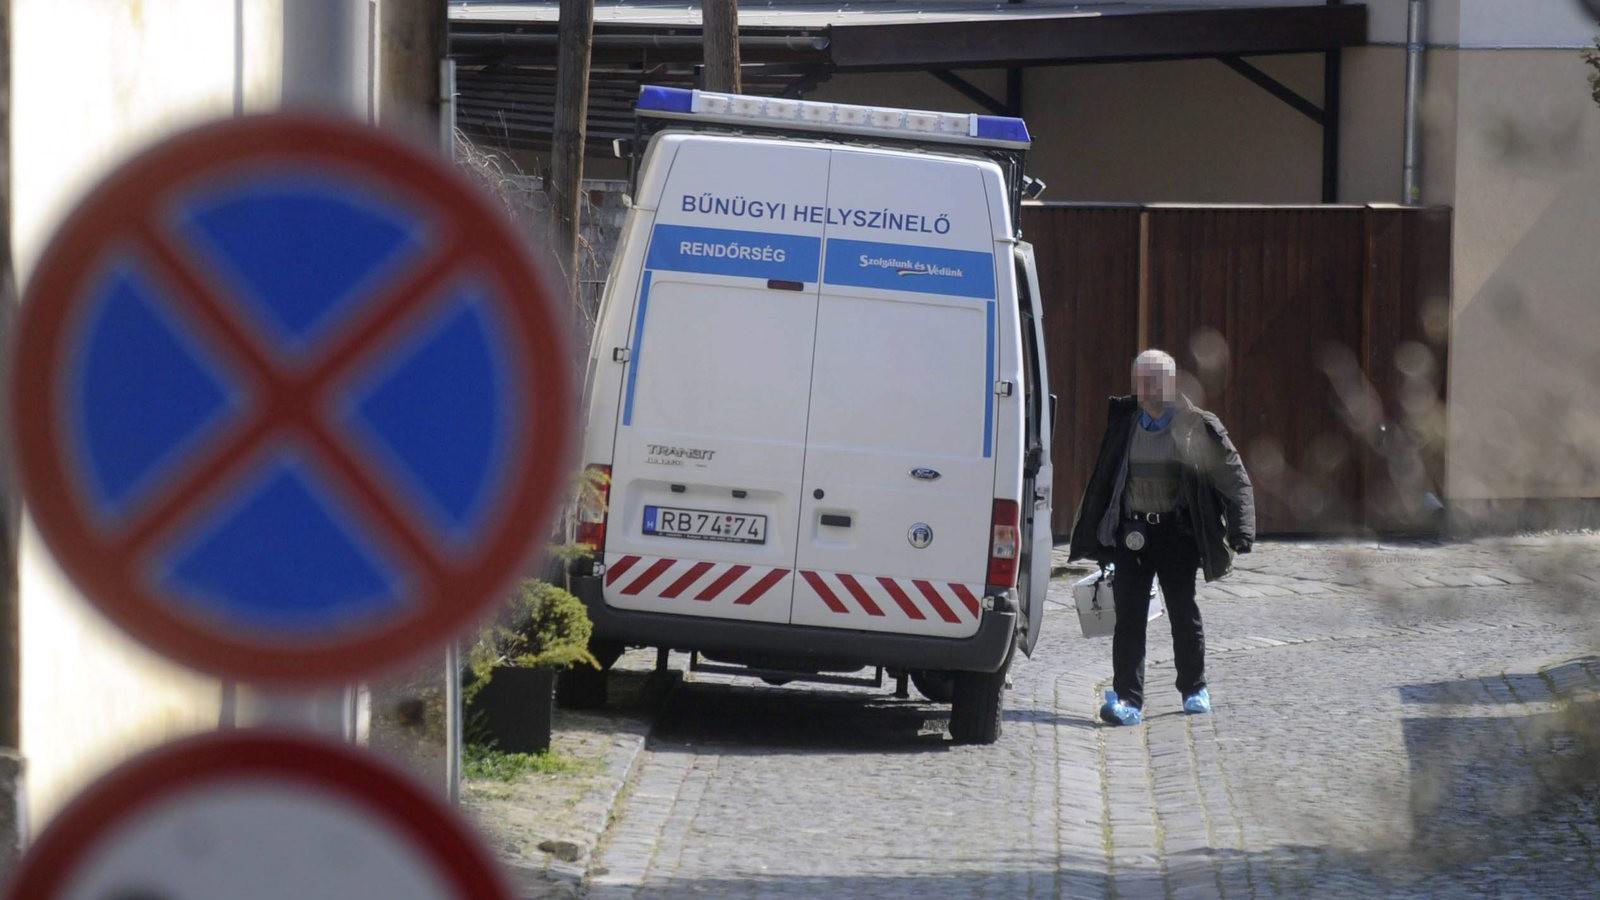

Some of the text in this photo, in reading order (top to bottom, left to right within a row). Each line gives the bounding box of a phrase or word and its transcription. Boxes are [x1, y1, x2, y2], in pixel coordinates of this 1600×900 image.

[682, 193, 951, 235] BŰNÜGYI HELYSZÍNELŐ
[680, 241, 786, 263] RENDŐRSÉG
[859, 254, 963, 278] Szolgálunk és Védünk
[646, 444, 716, 460] TRANSIT
